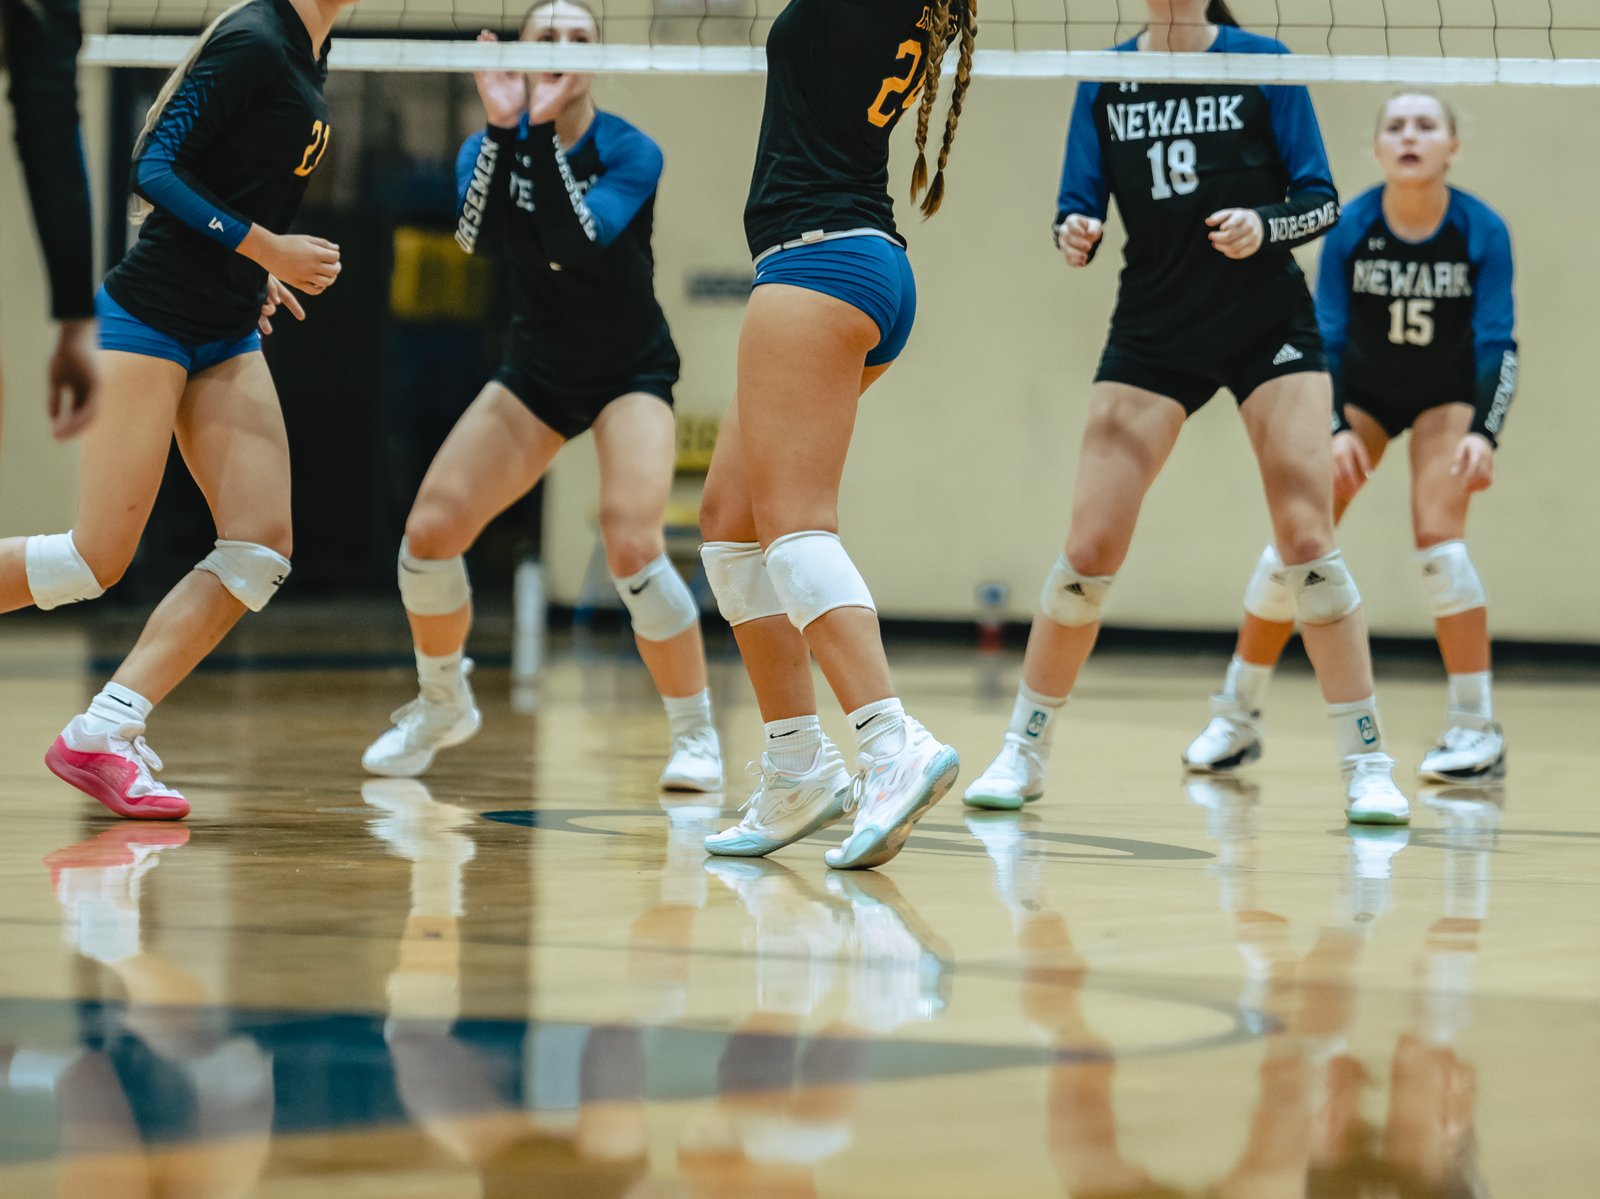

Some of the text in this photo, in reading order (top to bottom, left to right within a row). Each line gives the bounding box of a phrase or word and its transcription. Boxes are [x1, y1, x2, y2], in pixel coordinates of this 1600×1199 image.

[1106, 94, 1245, 142] NEWARK
[1147, 138, 1200, 201] 18
[1268, 201, 1342, 243] NORSEME
[1352, 259, 1473, 298] NEWARK
[1387, 299, 1436, 347] 15
